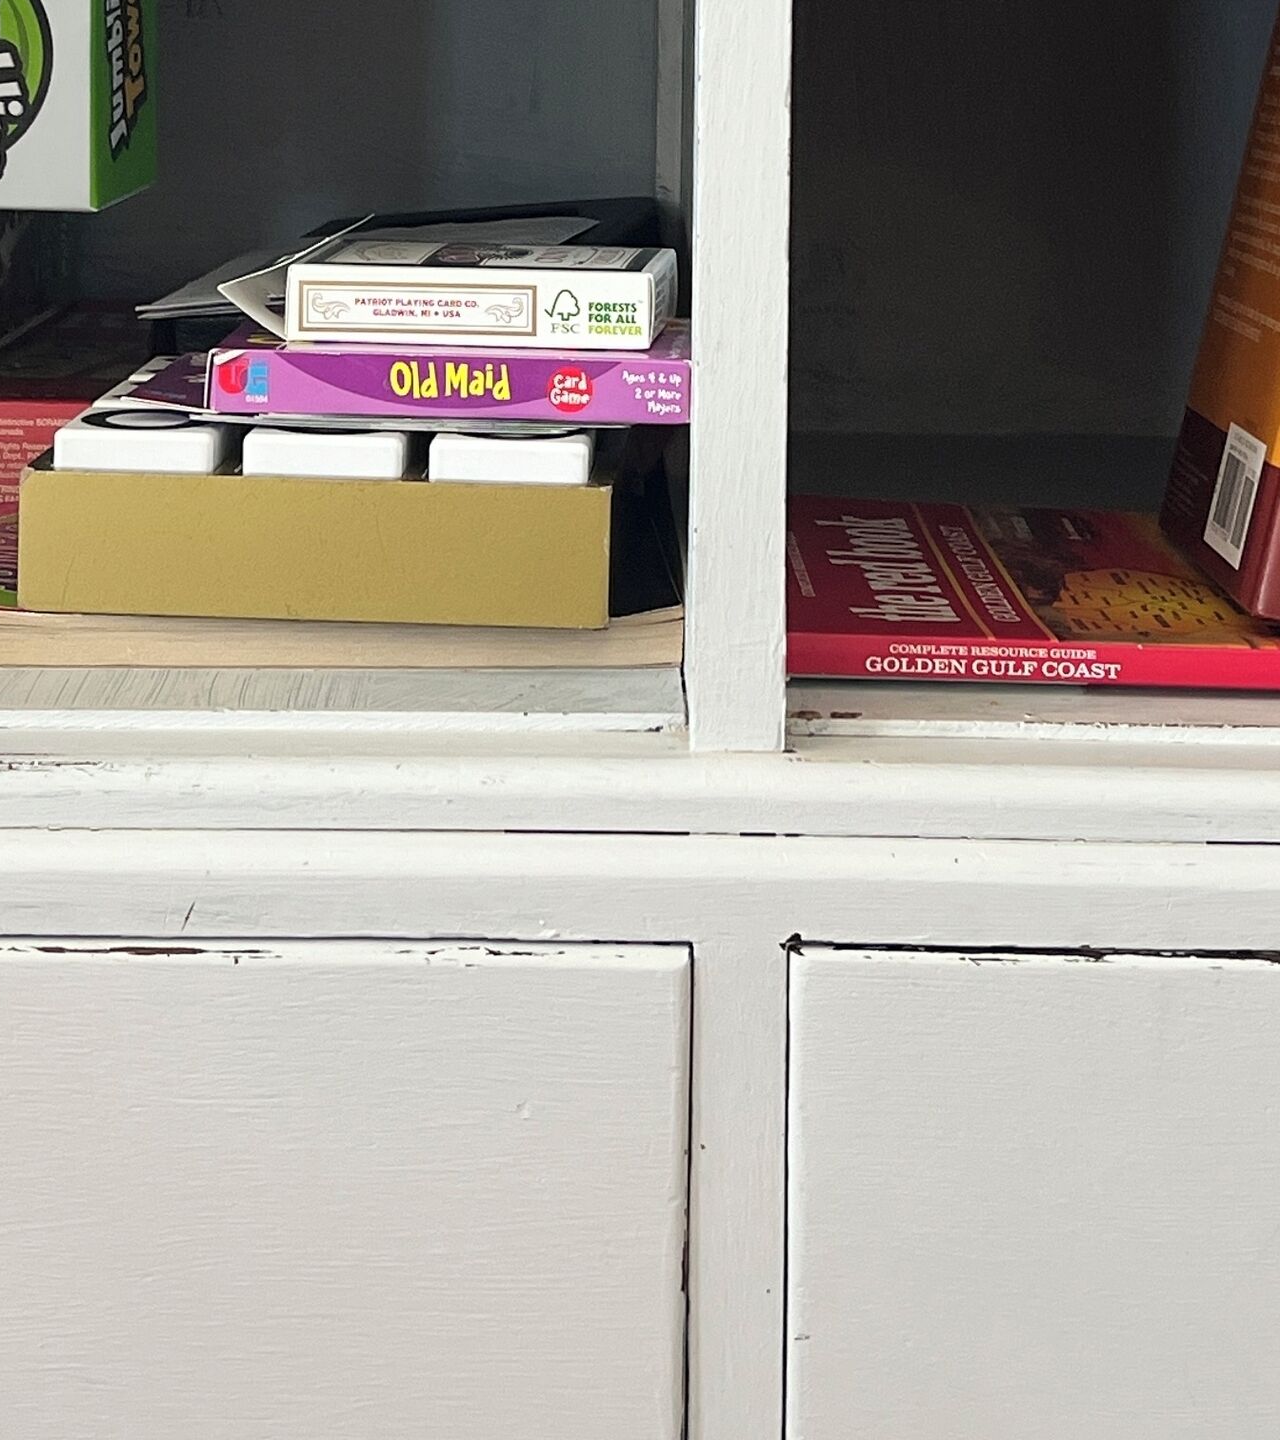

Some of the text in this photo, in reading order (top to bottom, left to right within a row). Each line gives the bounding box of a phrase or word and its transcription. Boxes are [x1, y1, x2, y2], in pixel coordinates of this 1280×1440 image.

[588, 313, 637, 325] FOR ALL
[550, 322, 581, 335] FSC
[588, 325, 642, 336] FOREVER
[389, 361, 511, 401] Old Maid
[553, 371, 588, 391] Card
[550, 387, 591, 405] Game
[889, 643, 1097, 660] COMPLETE RESOURCE GUIDE
[865, 655, 1122, 680] GOLDEN GULF COAST
